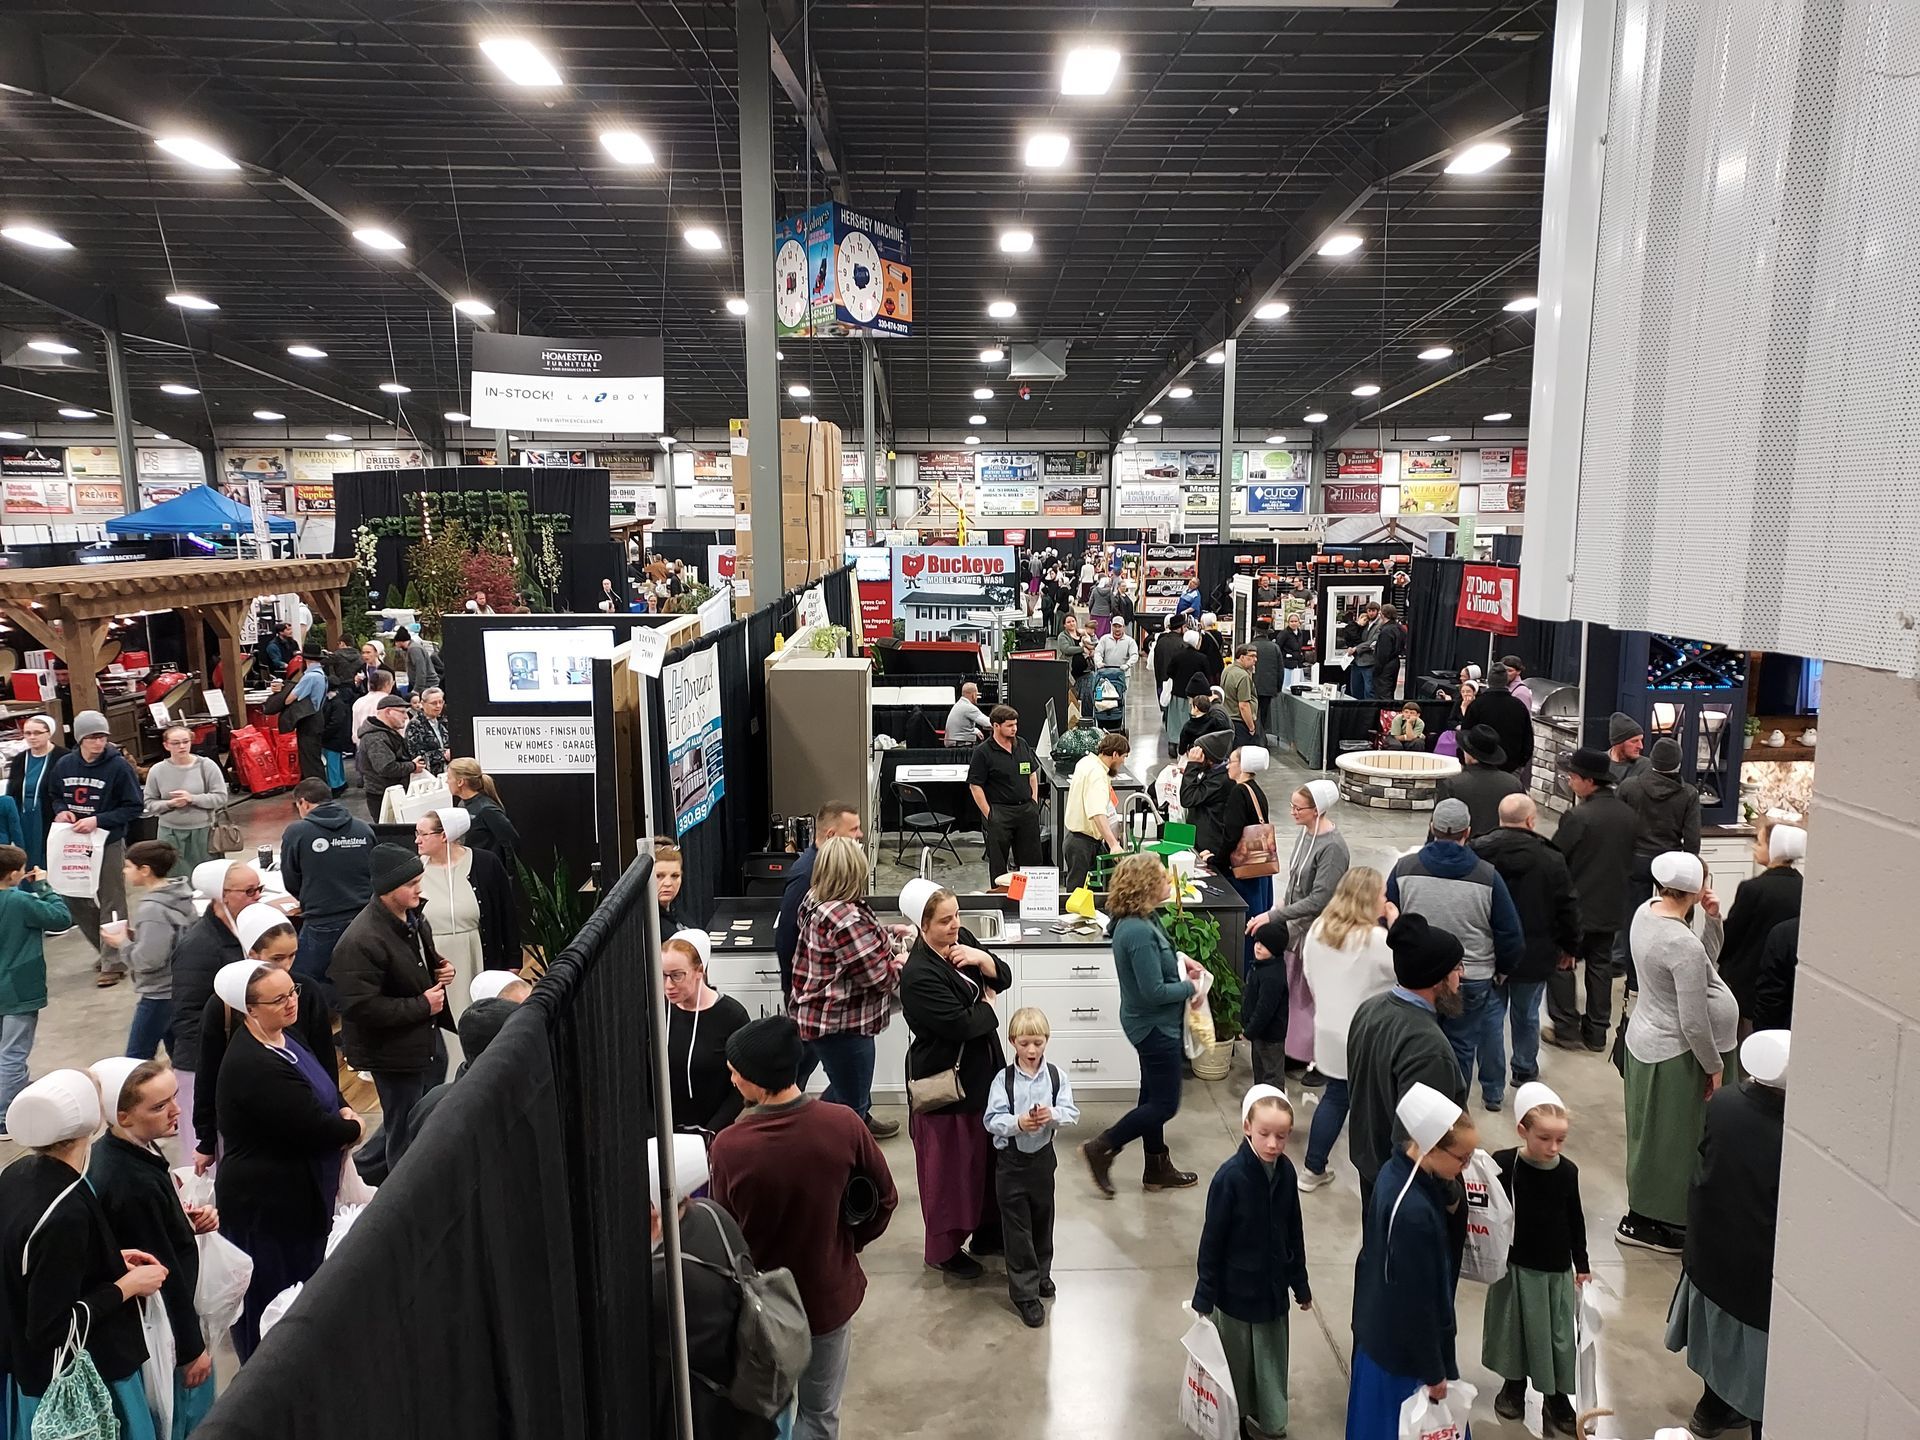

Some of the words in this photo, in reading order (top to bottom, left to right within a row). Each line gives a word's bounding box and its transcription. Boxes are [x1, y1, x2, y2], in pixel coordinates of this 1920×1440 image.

[840, 208, 873, 232] HERSHEY
[874, 220, 904, 243] MACHINE
[541, 351, 602, 361] HOMESTEAD
[546, 360, 597, 368] FURNITURE
[485, 386, 554, 400] IN-STOCK!
[79, 491, 119, 499] PREMIER
[298, 490, 333, 500] Supplies
[1264, 488, 1298, 498] CUTCO
[927, 554, 1005, 575] Buckeye
[927, 576, 955, 584] MOBILE
[956, 576, 982, 584] POWER
[983, 576, 1005, 584] WASH
[485, 726, 541, 736] RENOVATIONS
[550, 726, 577, 736] FINISH
[504, 740, 522, 750] NEW
[526, 740, 553, 750] HOMES
[517, 754, 555, 763] REMODEL
